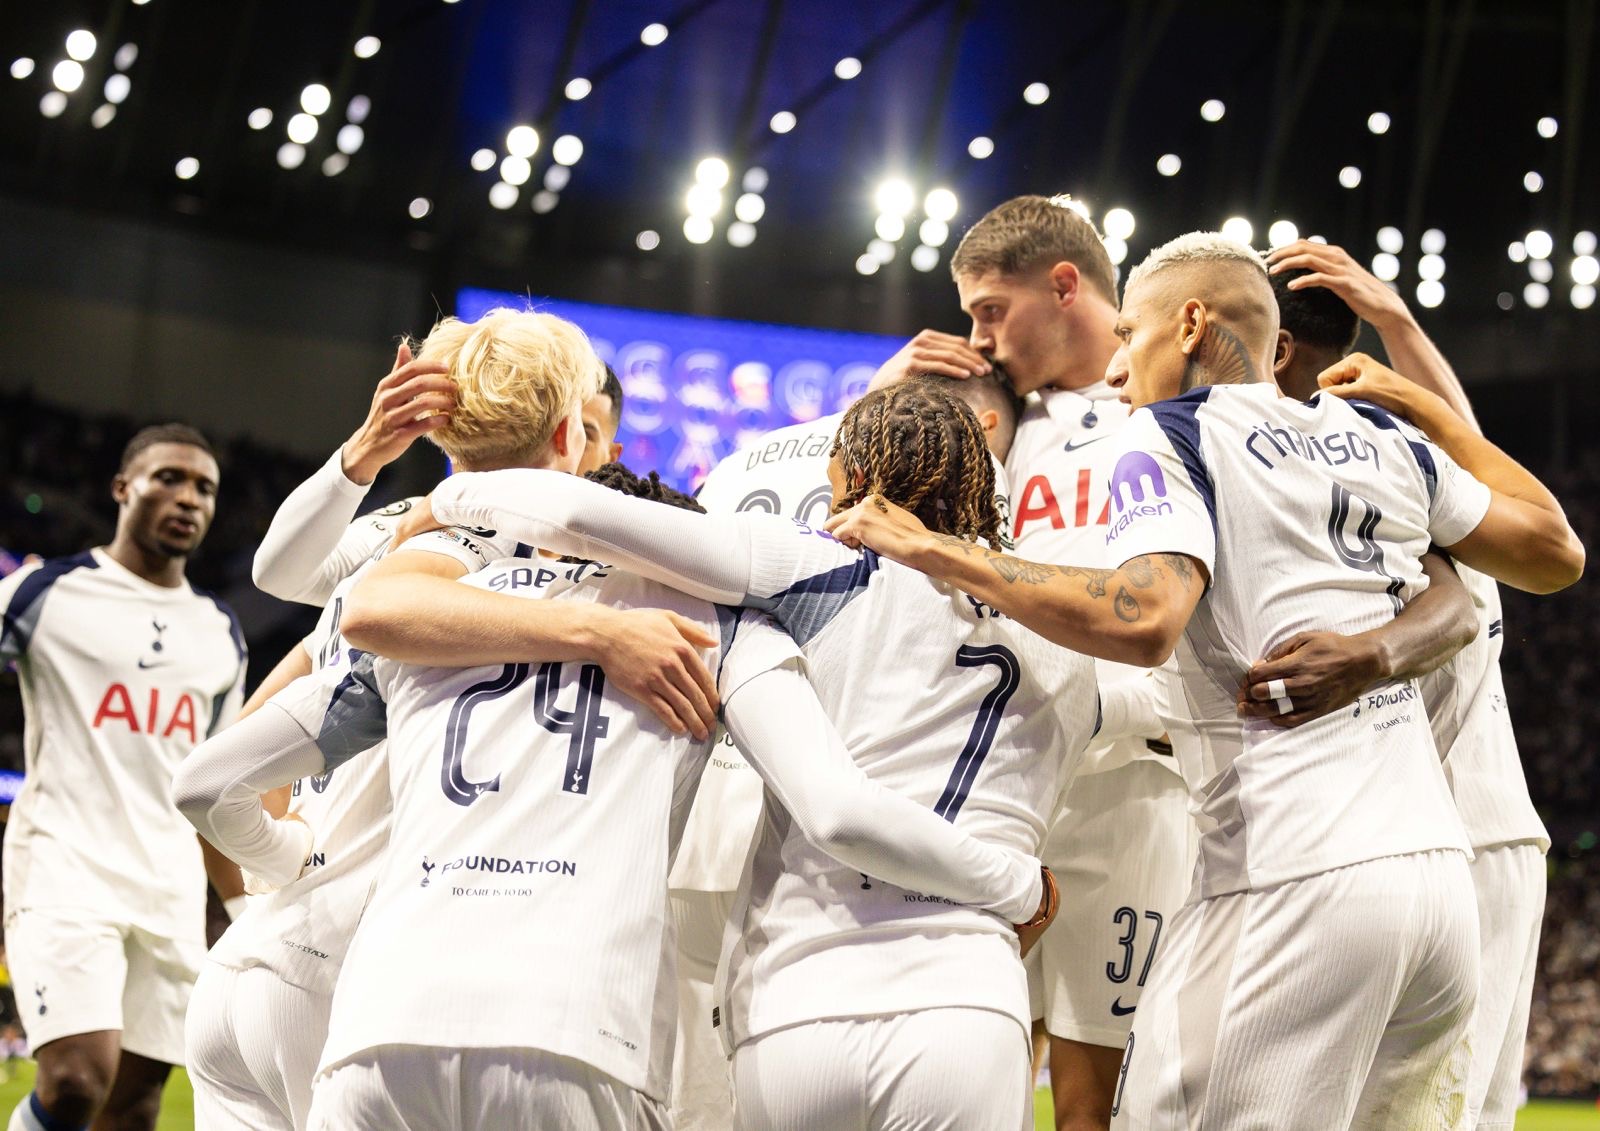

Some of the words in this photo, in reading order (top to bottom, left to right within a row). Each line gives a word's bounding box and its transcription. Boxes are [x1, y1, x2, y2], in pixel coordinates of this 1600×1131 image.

[1106, 500, 1174, 546] kraken
[93, 682, 196, 744] AIA
[441, 662, 609, 807] 24
[933, 644, 1020, 824] 7
[712, 758, 723, 768] TO
[441, 855, 577, 877] FOUNDATION
[452, 887, 464, 897] TO
[465, 888, 490, 897] CARE
[492, 888, 501, 897] IS
[518, 888, 532, 897] DO
[903, 895, 916, 903] TO
[917, 895, 942, 904] CARE
[1106, 907, 1163, 987] 37
